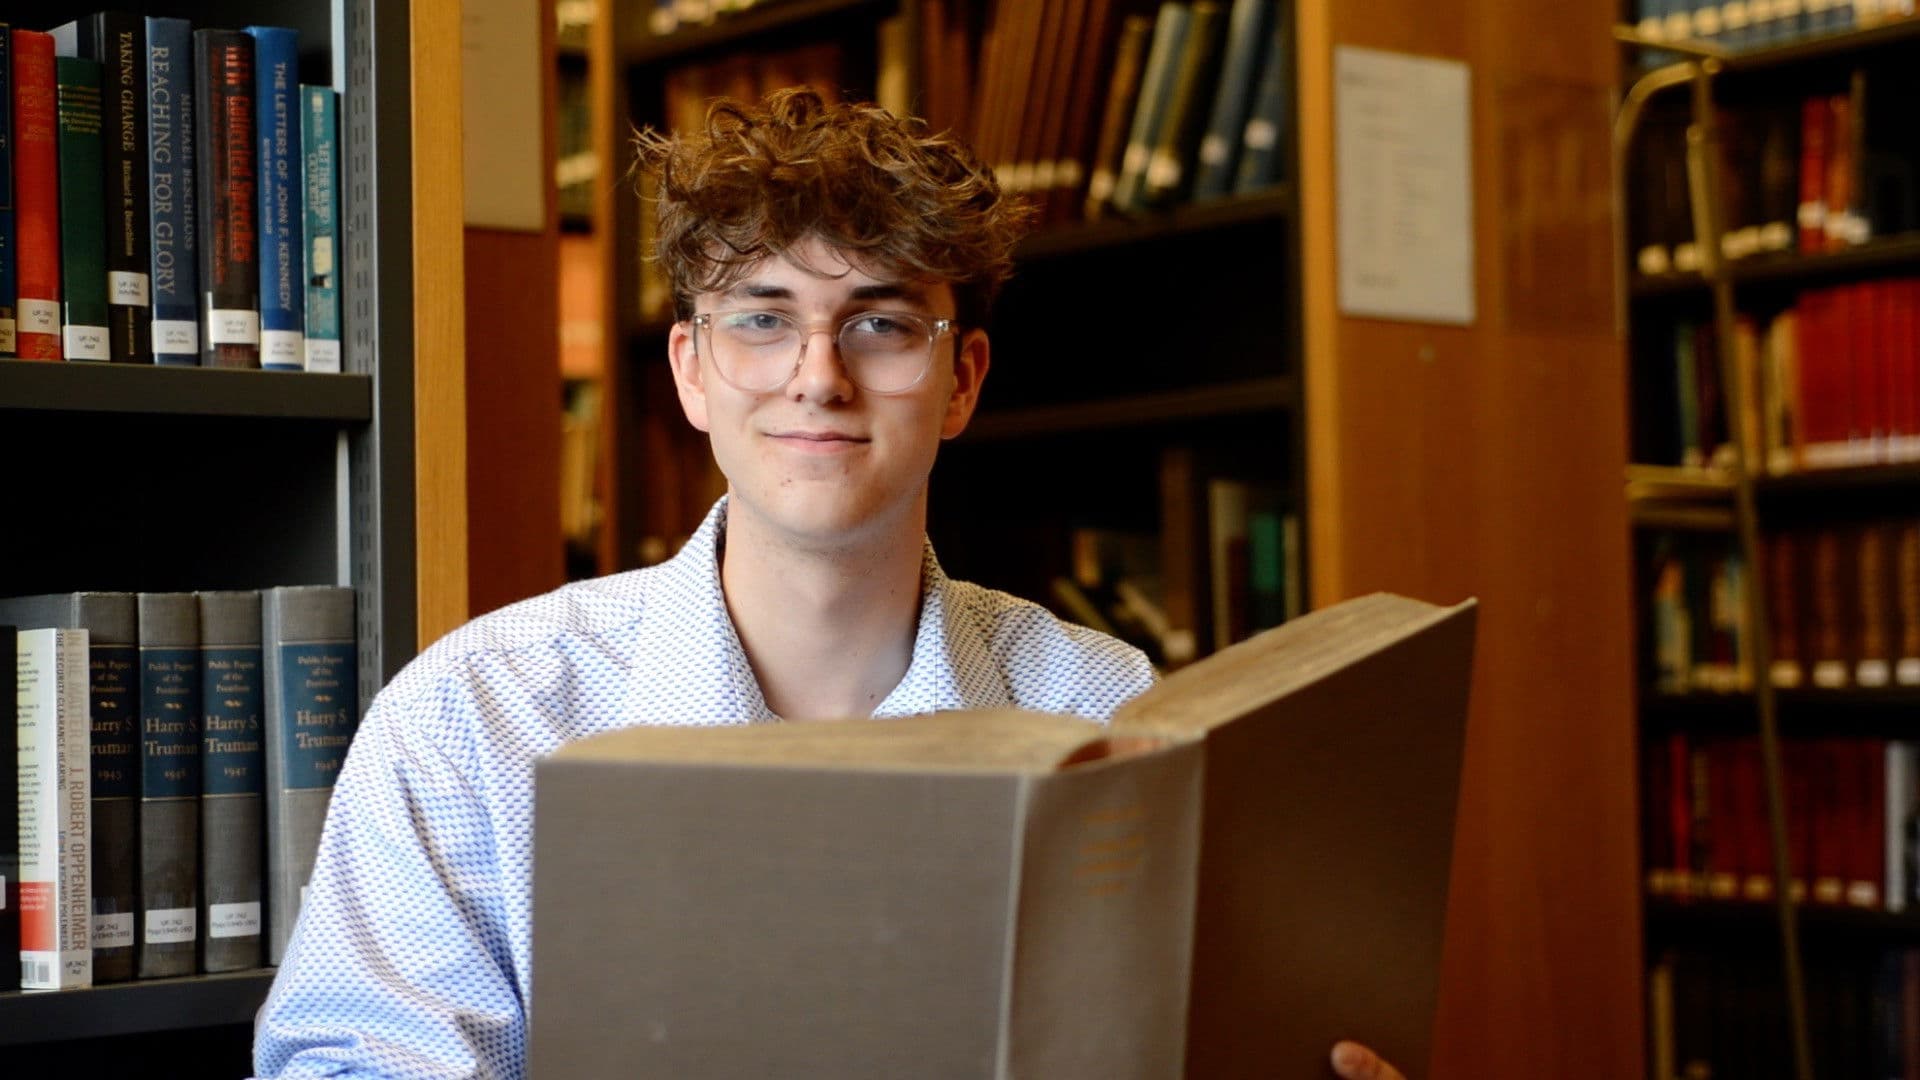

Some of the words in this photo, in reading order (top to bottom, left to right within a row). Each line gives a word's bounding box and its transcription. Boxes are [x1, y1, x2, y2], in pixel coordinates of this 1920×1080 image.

[120, 32, 134, 85] TAKING
[274, 62, 287, 90] THE
[121, 89, 135, 152] CHARGE
[151, 46, 171, 163] REACHING
[181, 93, 192, 161] MICHAEL
[275, 94, 288, 156] LETTERS
[276, 159, 288, 180] OF
[154, 172, 173, 213] FOR
[182, 168, 194, 250] BESCHLOSS
[277, 183, 289, 224] JOHN
[278, 227, 290, 239] F.
[155, 222, 175, 295] GLORY
[279, 242, 292, 311] KENNEDY
[56, 632, 64, 647] THE
[56, 652, 65, 694] SECURITY
[57, 698, 66, 748] CLEARANCE
[146, 718, 183, 736] Harry
[206, 715, 247, 734] Harry
[296, 710, 337, 728] Harry
[90, 743, 134, 755] ruman
[144, 741, 198, 756] Truman
[204, 738, 258, 753] Truman
[296, 732, 348, 748] Truman
[57, 752, 66, 790] HEARING
[70, 767, 84, 776] J.
[224, 767, 247, 778] 1947
[70, 781, 85, 837] ROBERT
[71, 843, 87, 950] OPPENHEIMER
